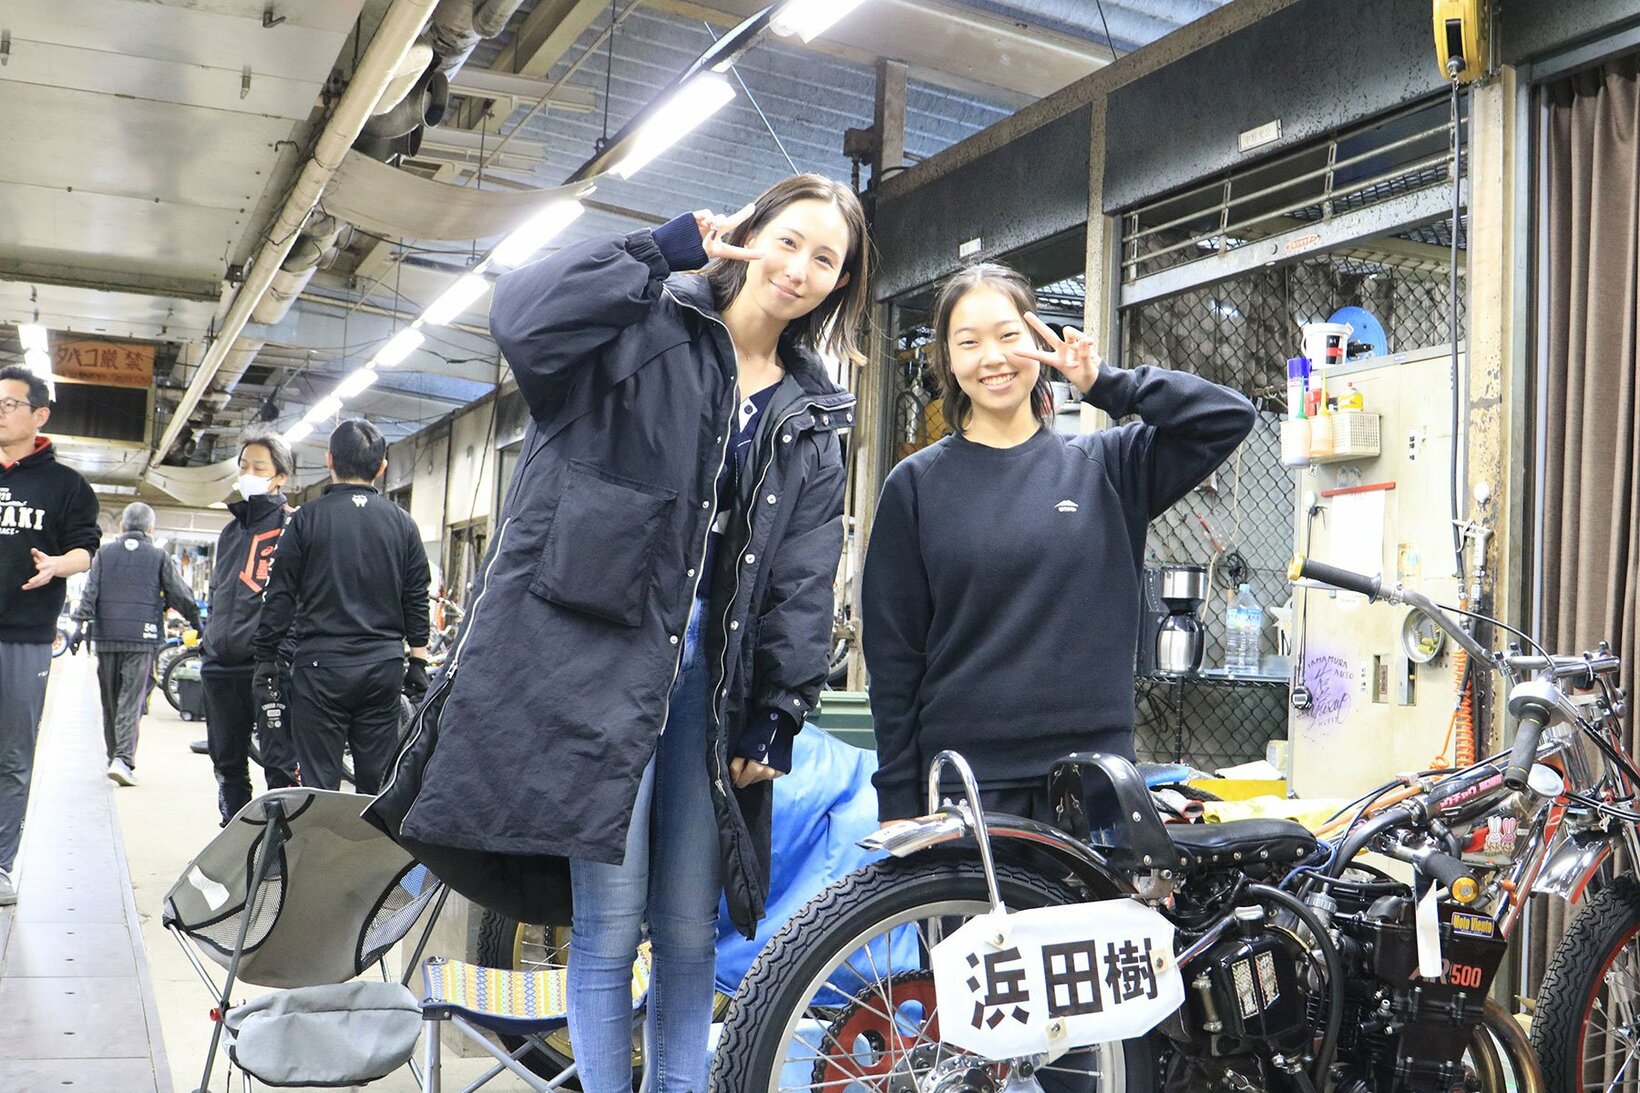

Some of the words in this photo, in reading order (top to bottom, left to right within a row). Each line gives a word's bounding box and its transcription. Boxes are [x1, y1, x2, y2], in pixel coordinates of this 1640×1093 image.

[0, 506, 46, 530] AKI
[1334, 668, 1354, 680] AUTO
[1453, 914, 1470, 930] Moto
[966, 937, 1159, 1030] 浜田樹
